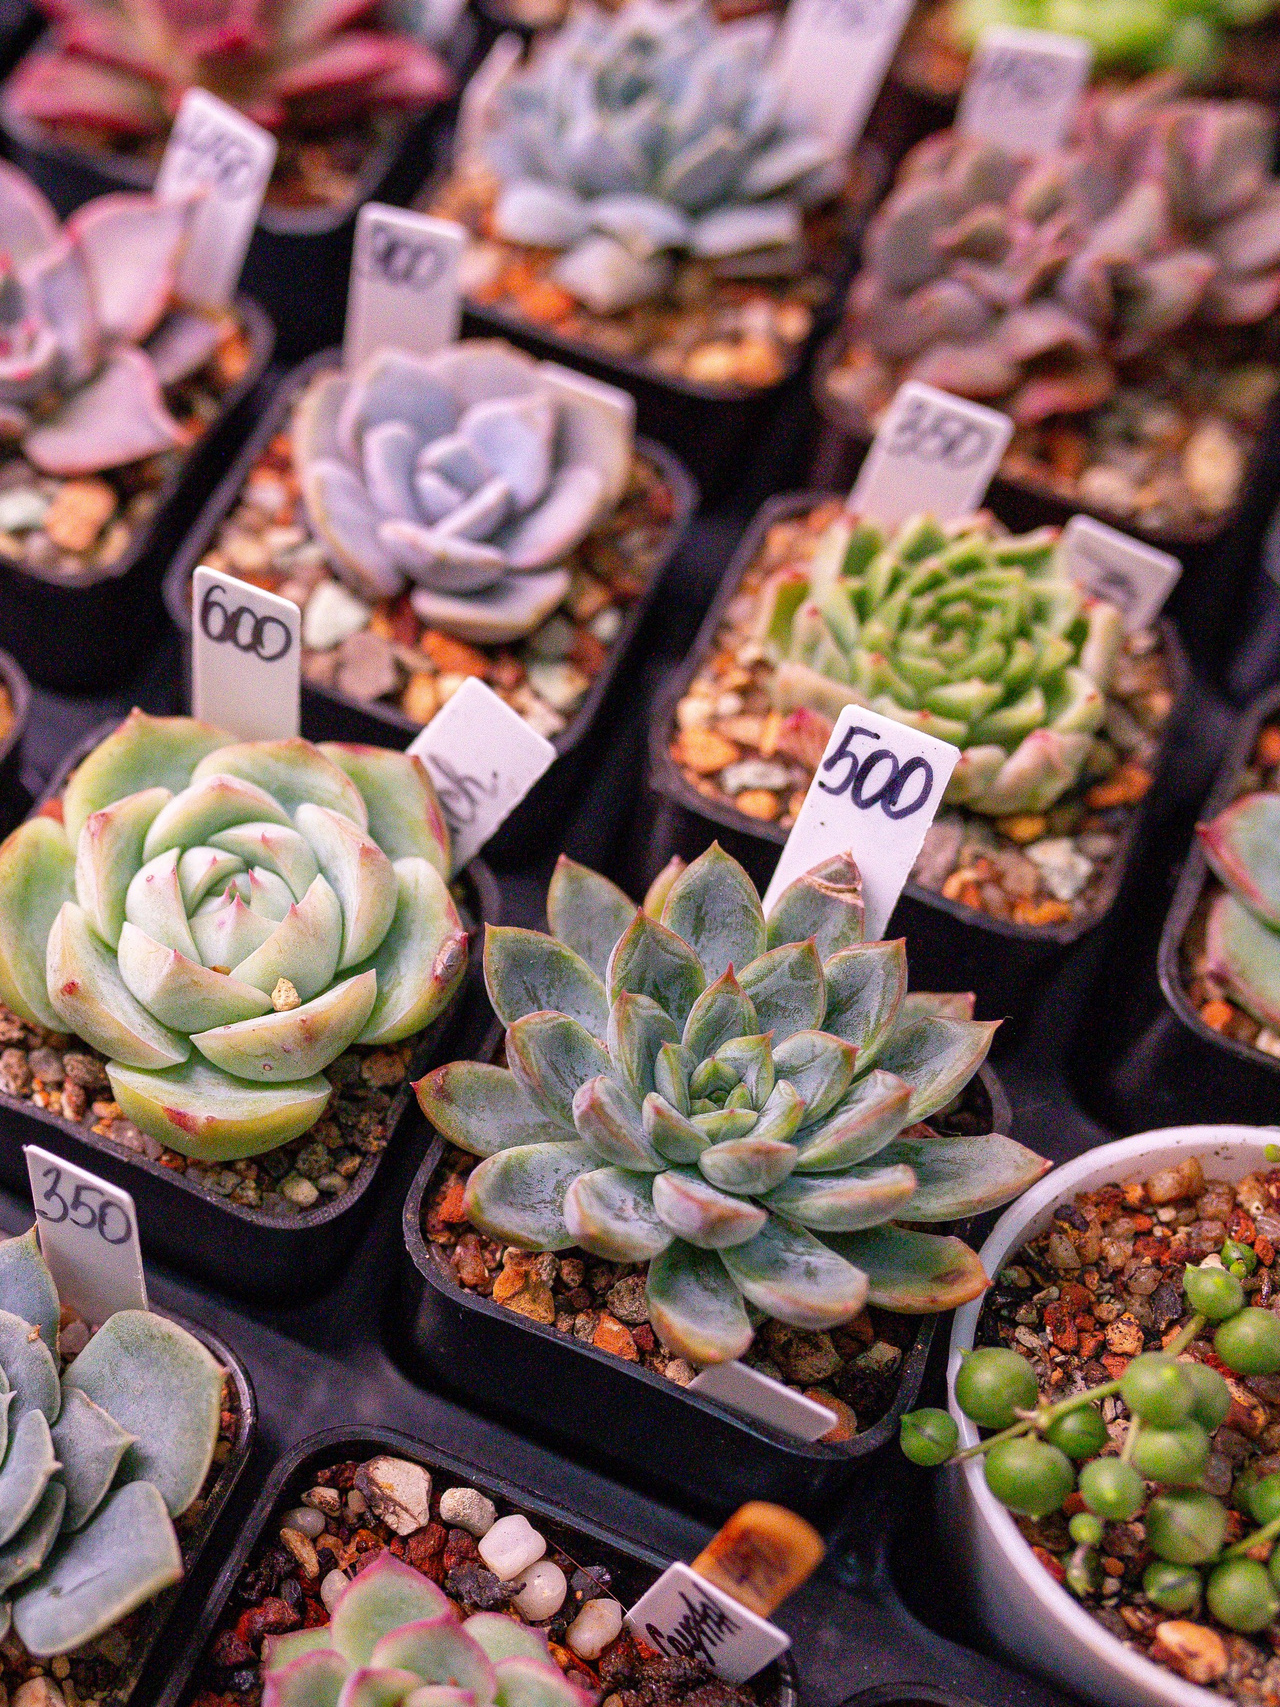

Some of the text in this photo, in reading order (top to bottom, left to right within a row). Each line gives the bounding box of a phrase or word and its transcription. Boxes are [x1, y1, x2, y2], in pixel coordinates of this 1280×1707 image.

[200, 584, 292, 663] 600
[818, 725, 934, 821] 500
[35, 1166, 133, 1246] 350
